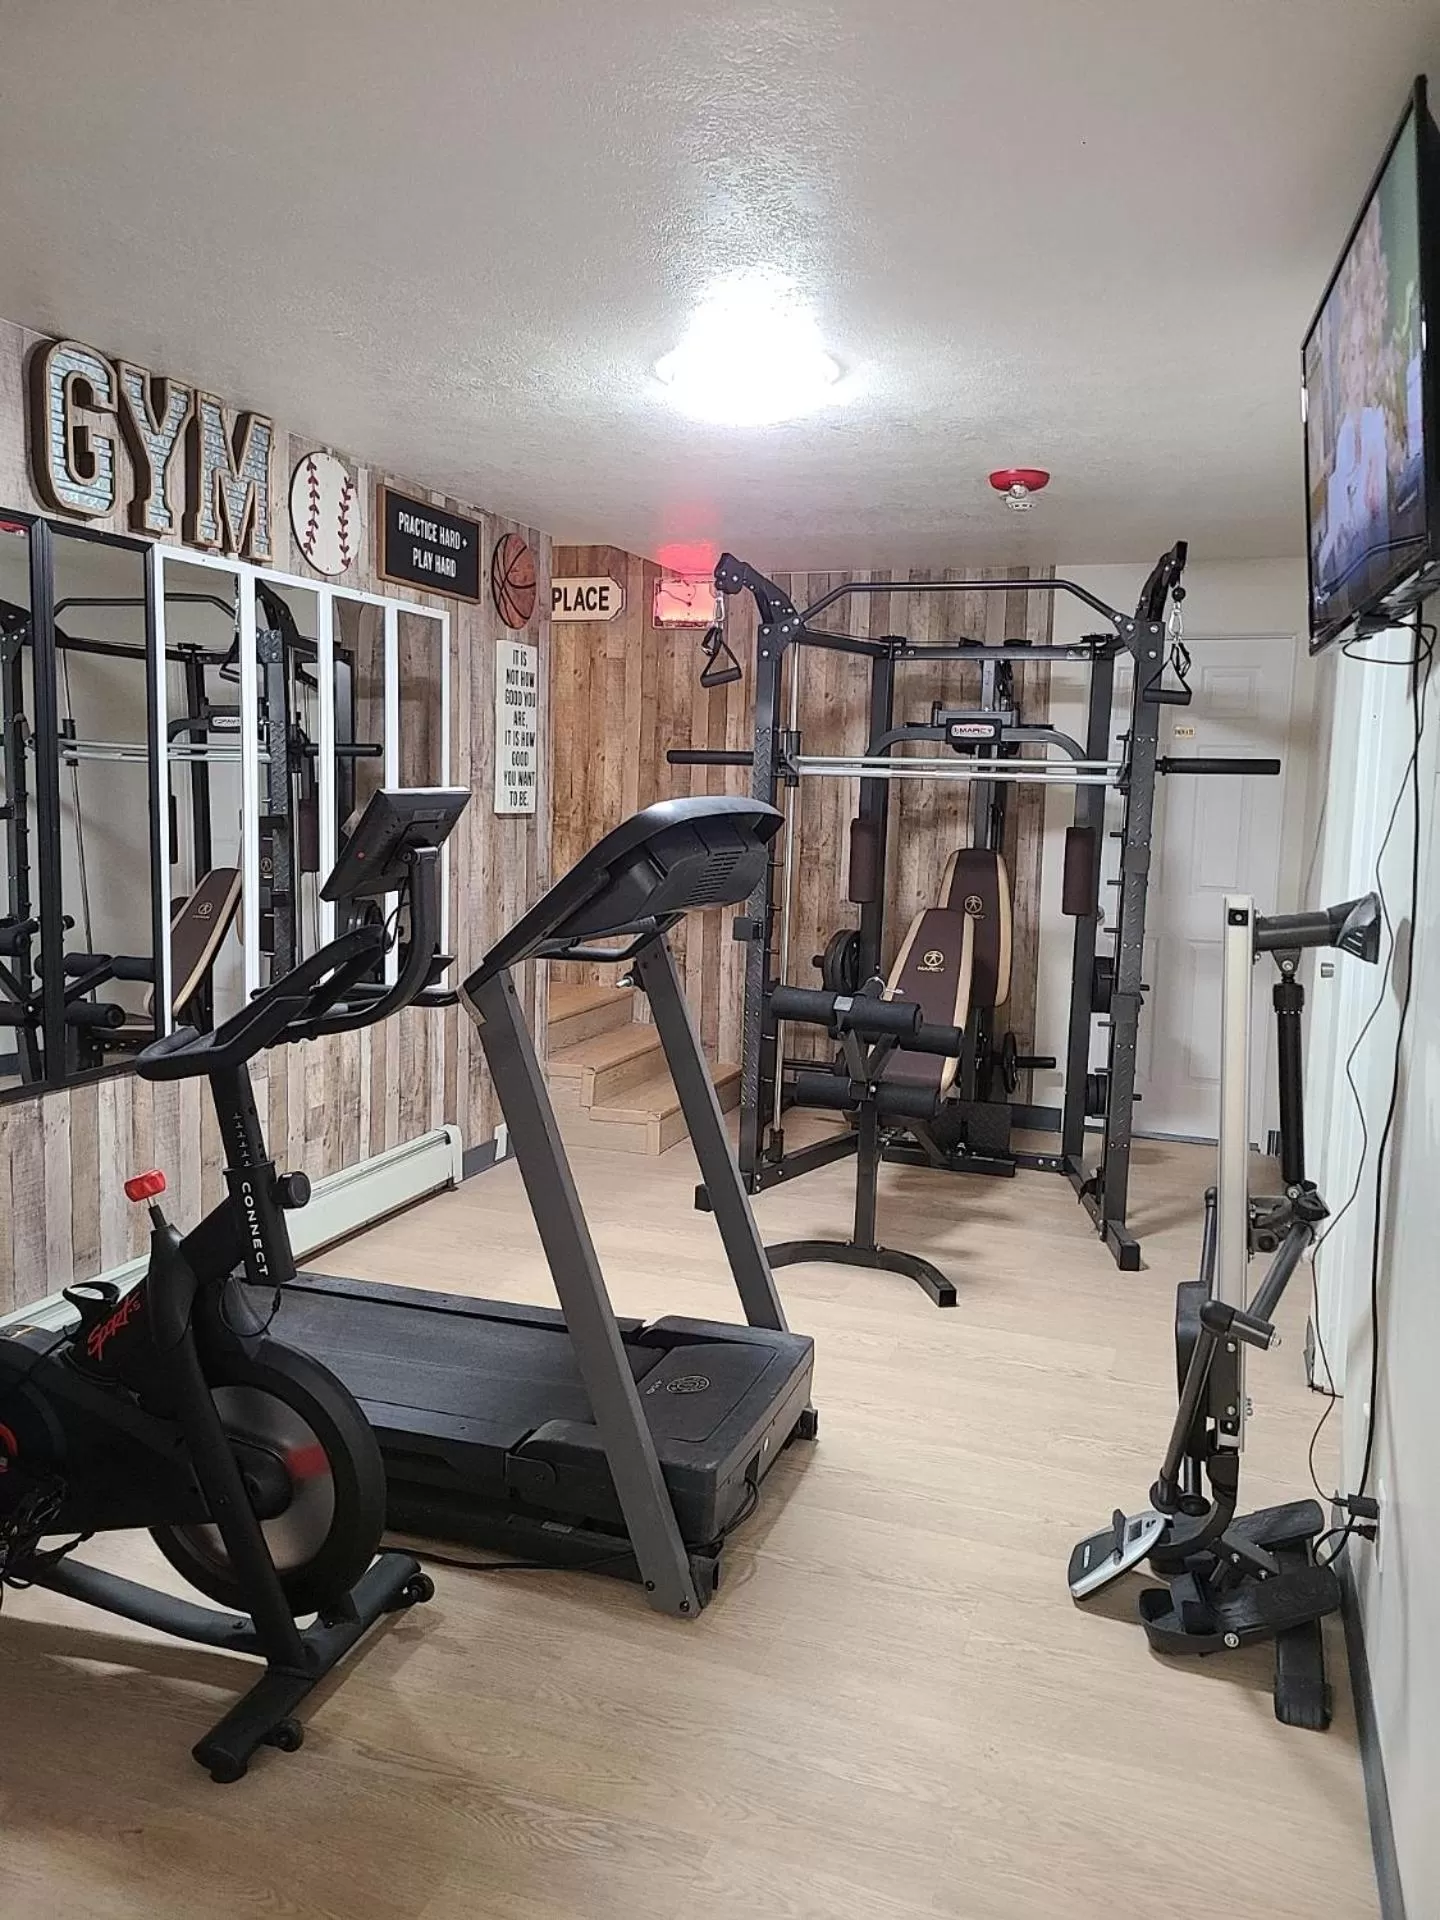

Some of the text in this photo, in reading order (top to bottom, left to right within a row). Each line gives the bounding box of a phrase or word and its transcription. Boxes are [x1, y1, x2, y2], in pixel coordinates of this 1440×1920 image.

[29, 340, 273, 562] GYM
[398, 511, 438, 543] PRACTICE
[439, 525, 461, 550] HARD
[412, 547, 457, 578] PLAY HARD
[551, 586, 610, 611] PLACE
[512, 649, 527, 667] IT IS
[506, 668, 535, 688] NOT HOW
[505, 688, 536, 708] GOOD YOU
[513, 710, 528, 729] ARE,
[504, 730, 535, 748] IT IS HOW
[511, 751, 530, 767] GOOD
[503, 770, 535, 787] YOU WANT
[509, 790, 518, 807] TO
[242, 1182, 269, 1276] CONNECT
